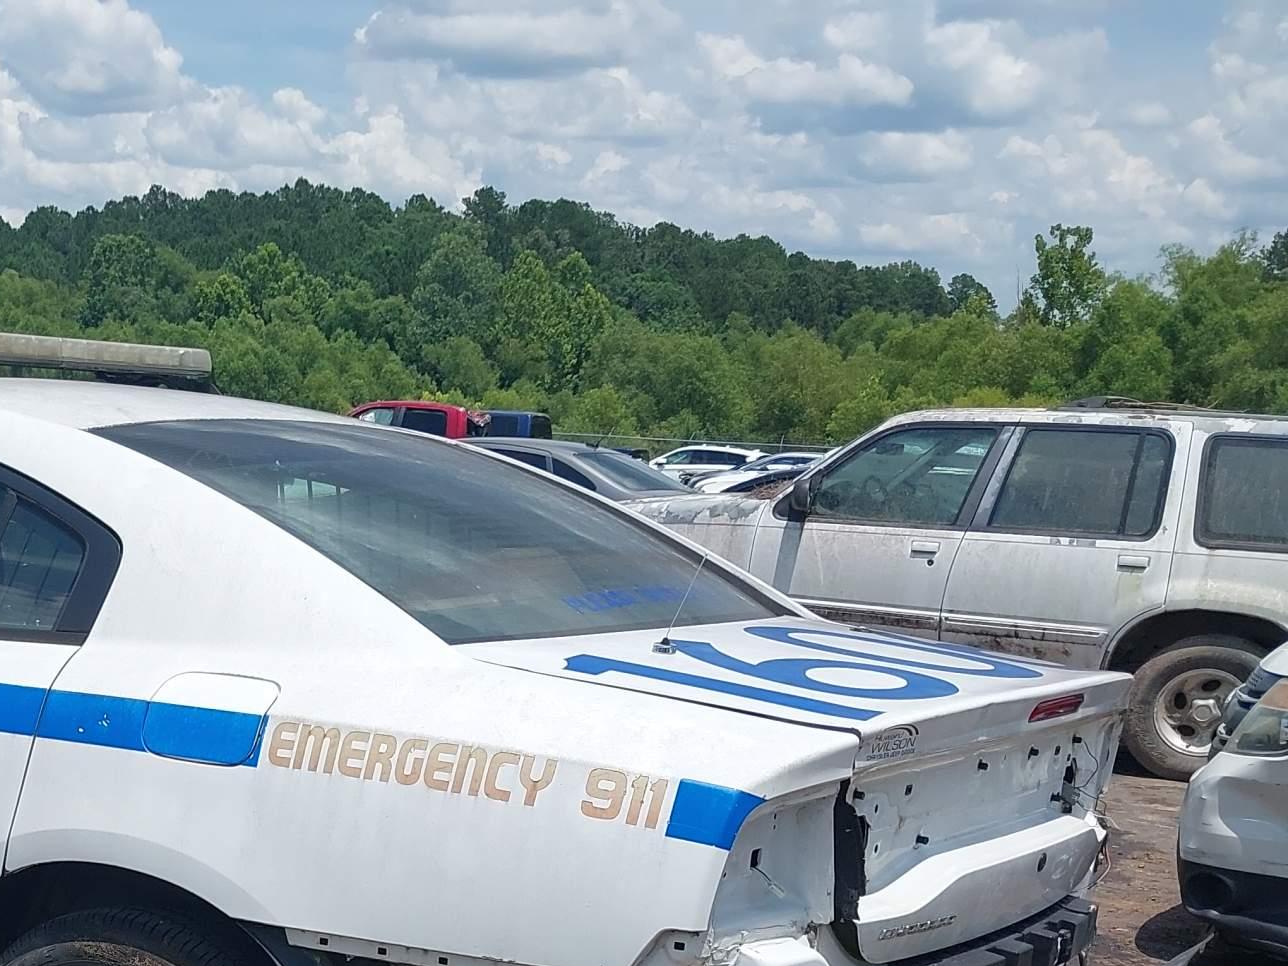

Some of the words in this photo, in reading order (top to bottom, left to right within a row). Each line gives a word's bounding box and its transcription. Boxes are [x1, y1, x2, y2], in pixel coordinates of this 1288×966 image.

[268, 721, 558, 807] EMERGENCY
[581, 767, 669, 830] 911
[871, 737, 917, 753] WILSON
